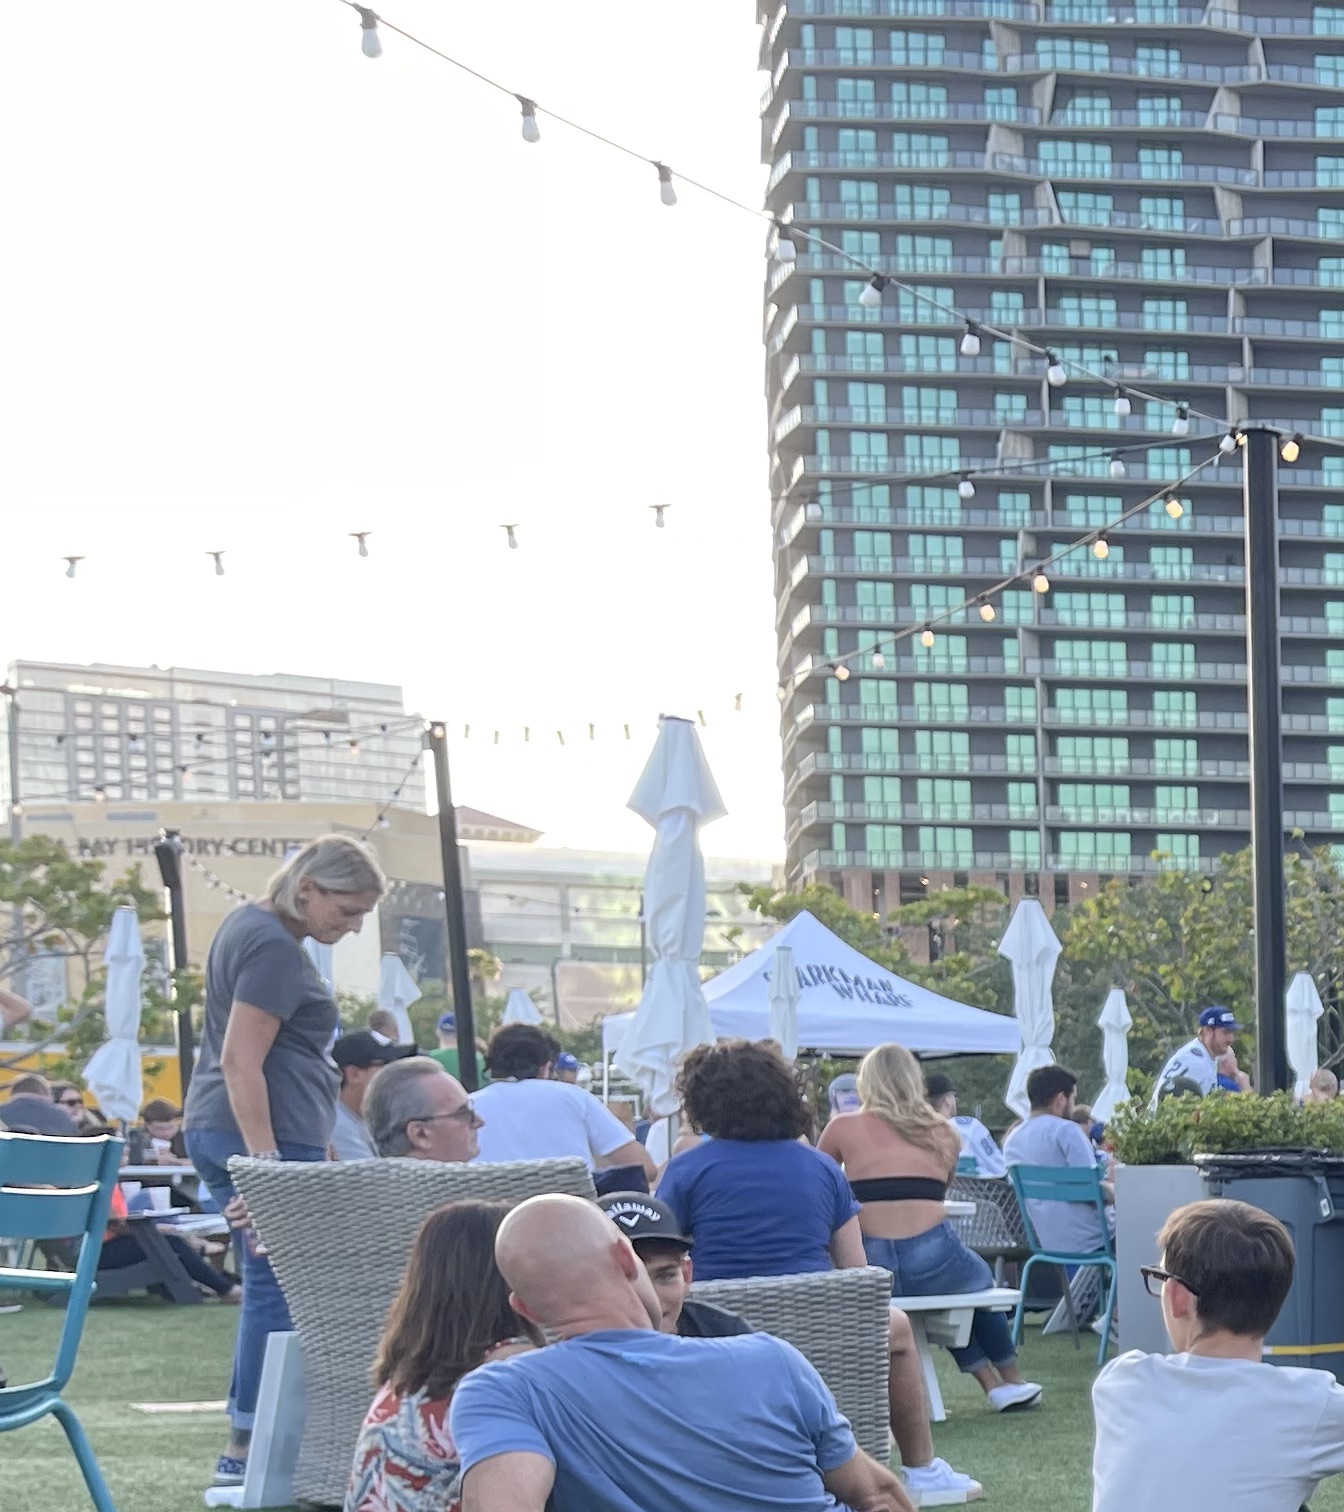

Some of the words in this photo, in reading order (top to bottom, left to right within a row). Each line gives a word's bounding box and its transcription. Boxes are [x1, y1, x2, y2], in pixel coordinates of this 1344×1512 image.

[127, 838, 224, 857] HISORY
[231, 838, 318, 857] CENT
[606, 1202, 661, 1222] allaway
